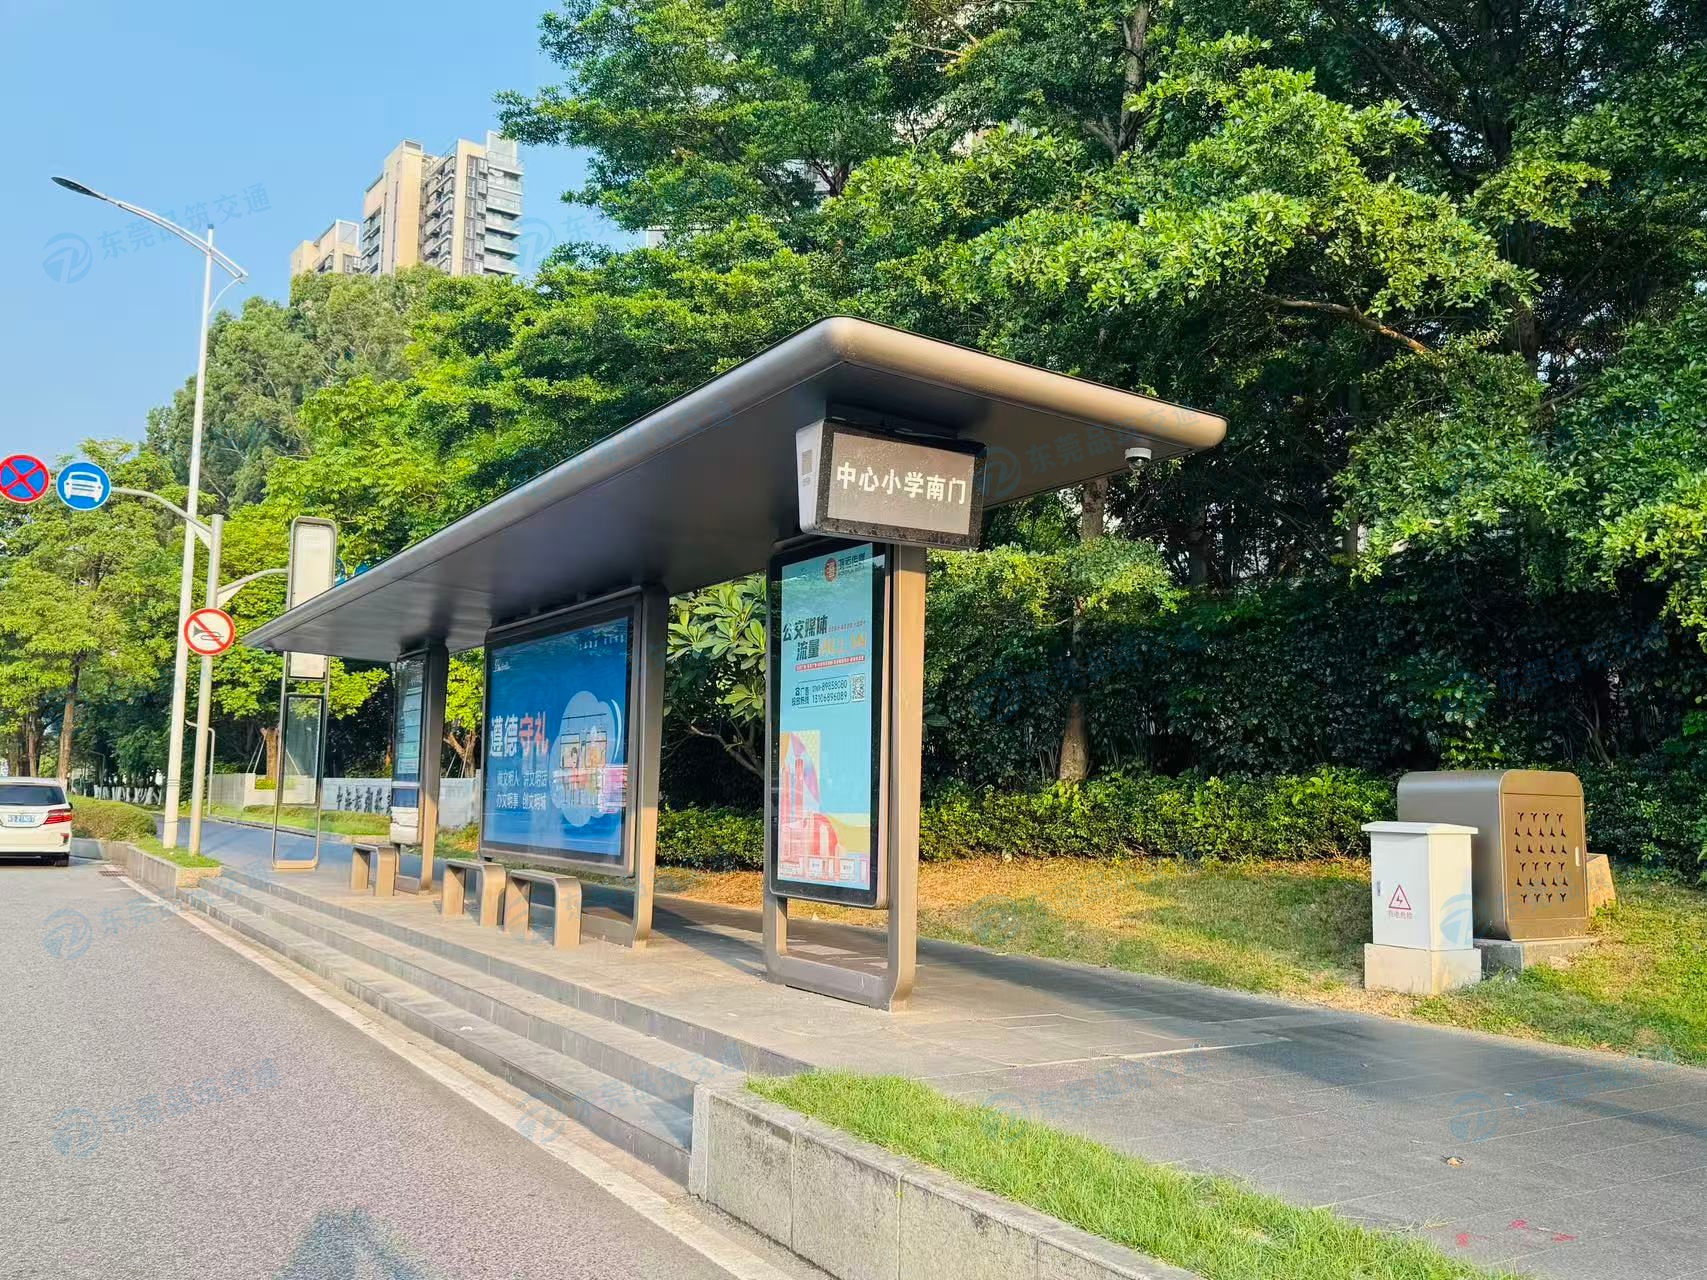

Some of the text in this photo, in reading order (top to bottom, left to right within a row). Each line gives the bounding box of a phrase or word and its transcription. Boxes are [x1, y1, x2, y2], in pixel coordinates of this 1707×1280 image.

[836, 461, 967, 505] 中心小学南门
[783, 614, 828, 641] 公交媒体
[796, 639, 820, 661] 流量
[490, 711, 549, 757] 遵德守礼
[496, 792, 519, 809] 办文明事
